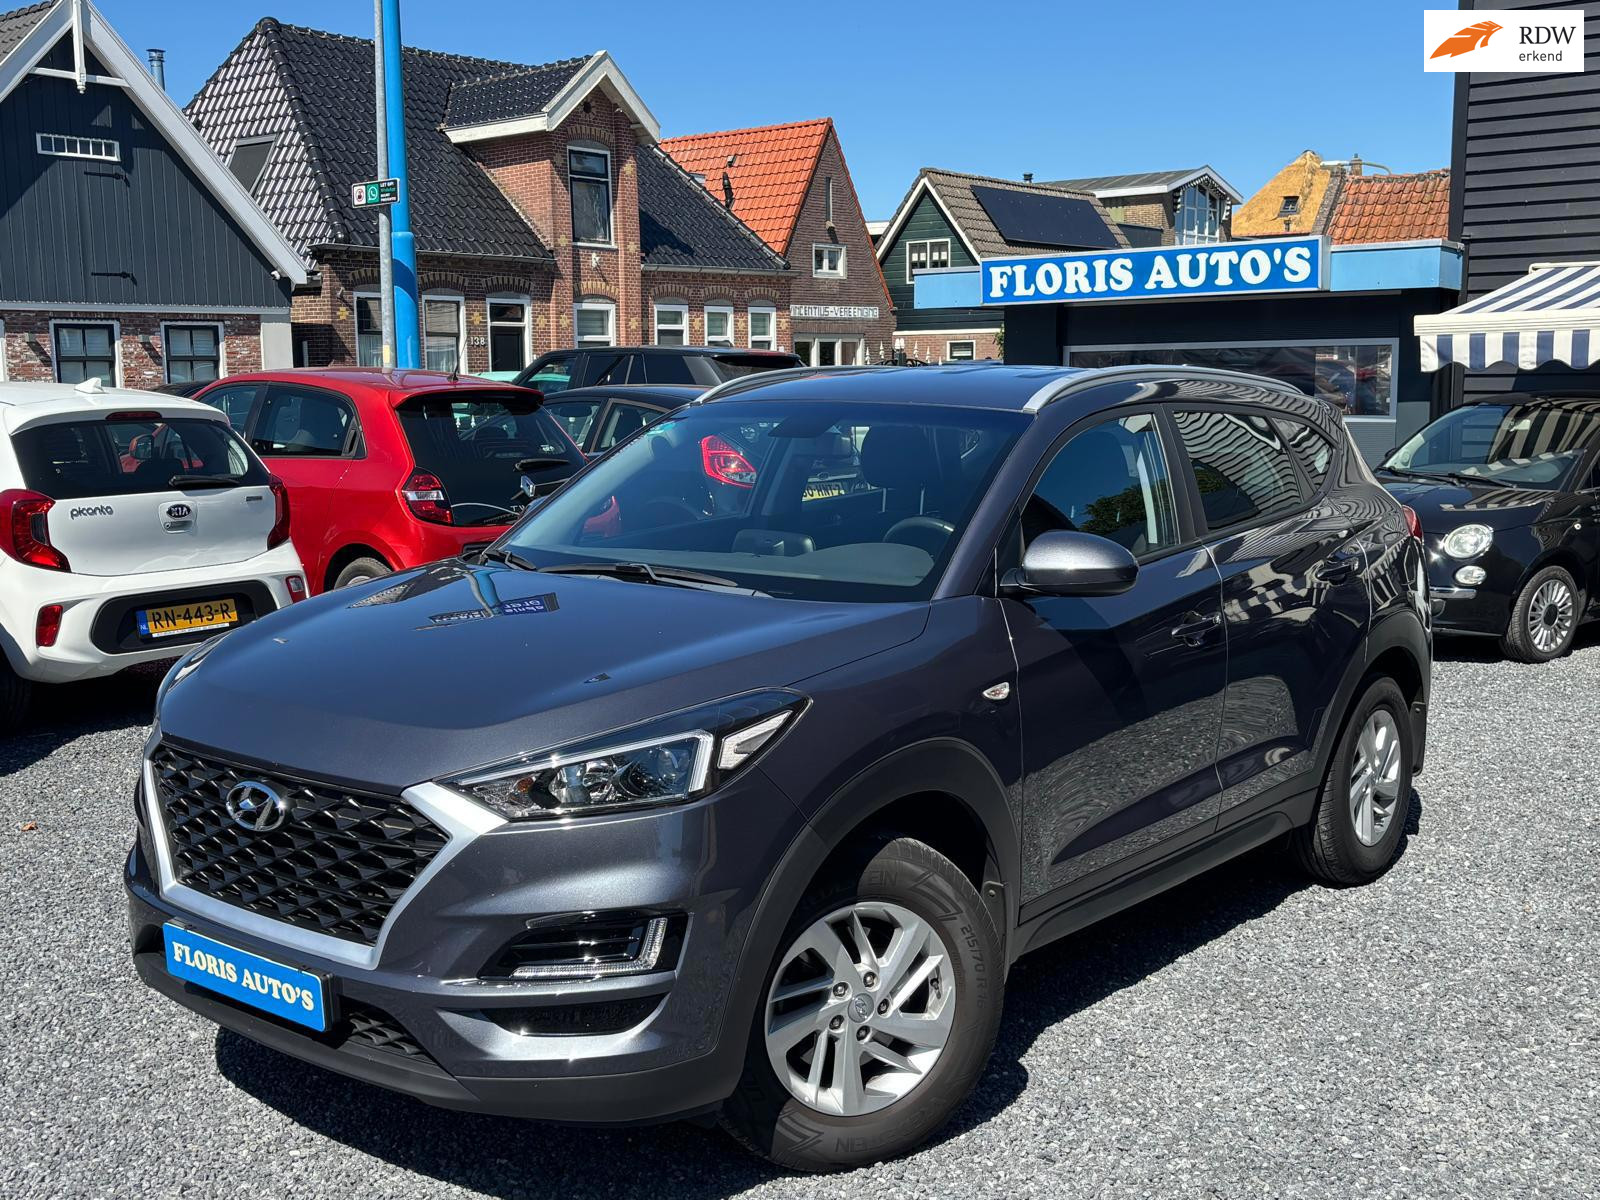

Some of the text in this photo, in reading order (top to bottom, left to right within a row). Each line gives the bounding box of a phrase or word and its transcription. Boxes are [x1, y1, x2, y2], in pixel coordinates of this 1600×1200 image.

[989, 246, 1312, 298] FLORIS AUTO'S
[470, 336, 485, 345] 138
[70, 504, 114, 520] picanto
[170, 505, 191, 517] KIA
[152, 602, 232, 630] RN-443-R
[172, 941, 315, 1011] FLORIS AUTO'S
